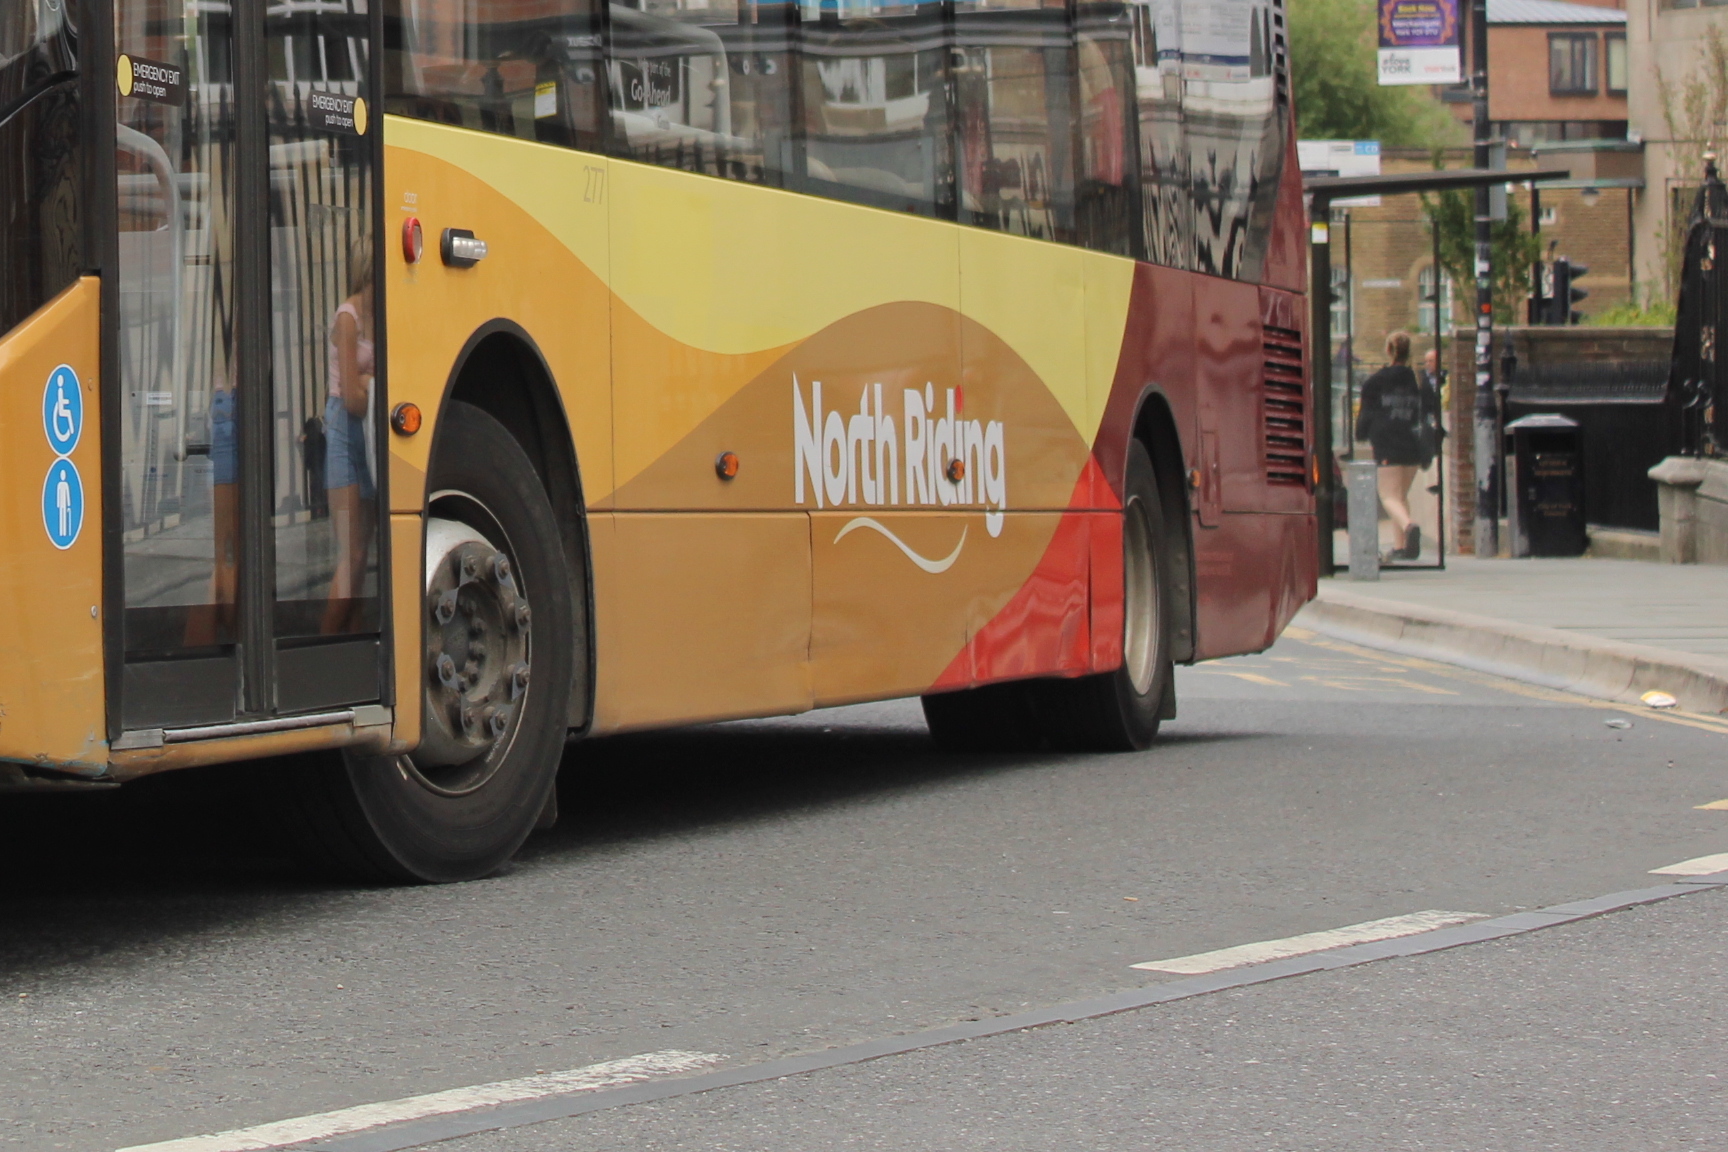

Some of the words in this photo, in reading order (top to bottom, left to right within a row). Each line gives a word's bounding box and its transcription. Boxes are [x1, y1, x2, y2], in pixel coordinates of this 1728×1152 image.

[133, 62, 169, 83] EMERGENCY
[133, 81, 146, 94] push
[153, 85, 167, 98] open
[583, 164, 606, 205] 277
[792, 371, 899, 509] North
[903, 381, 1007, 538] Riding
